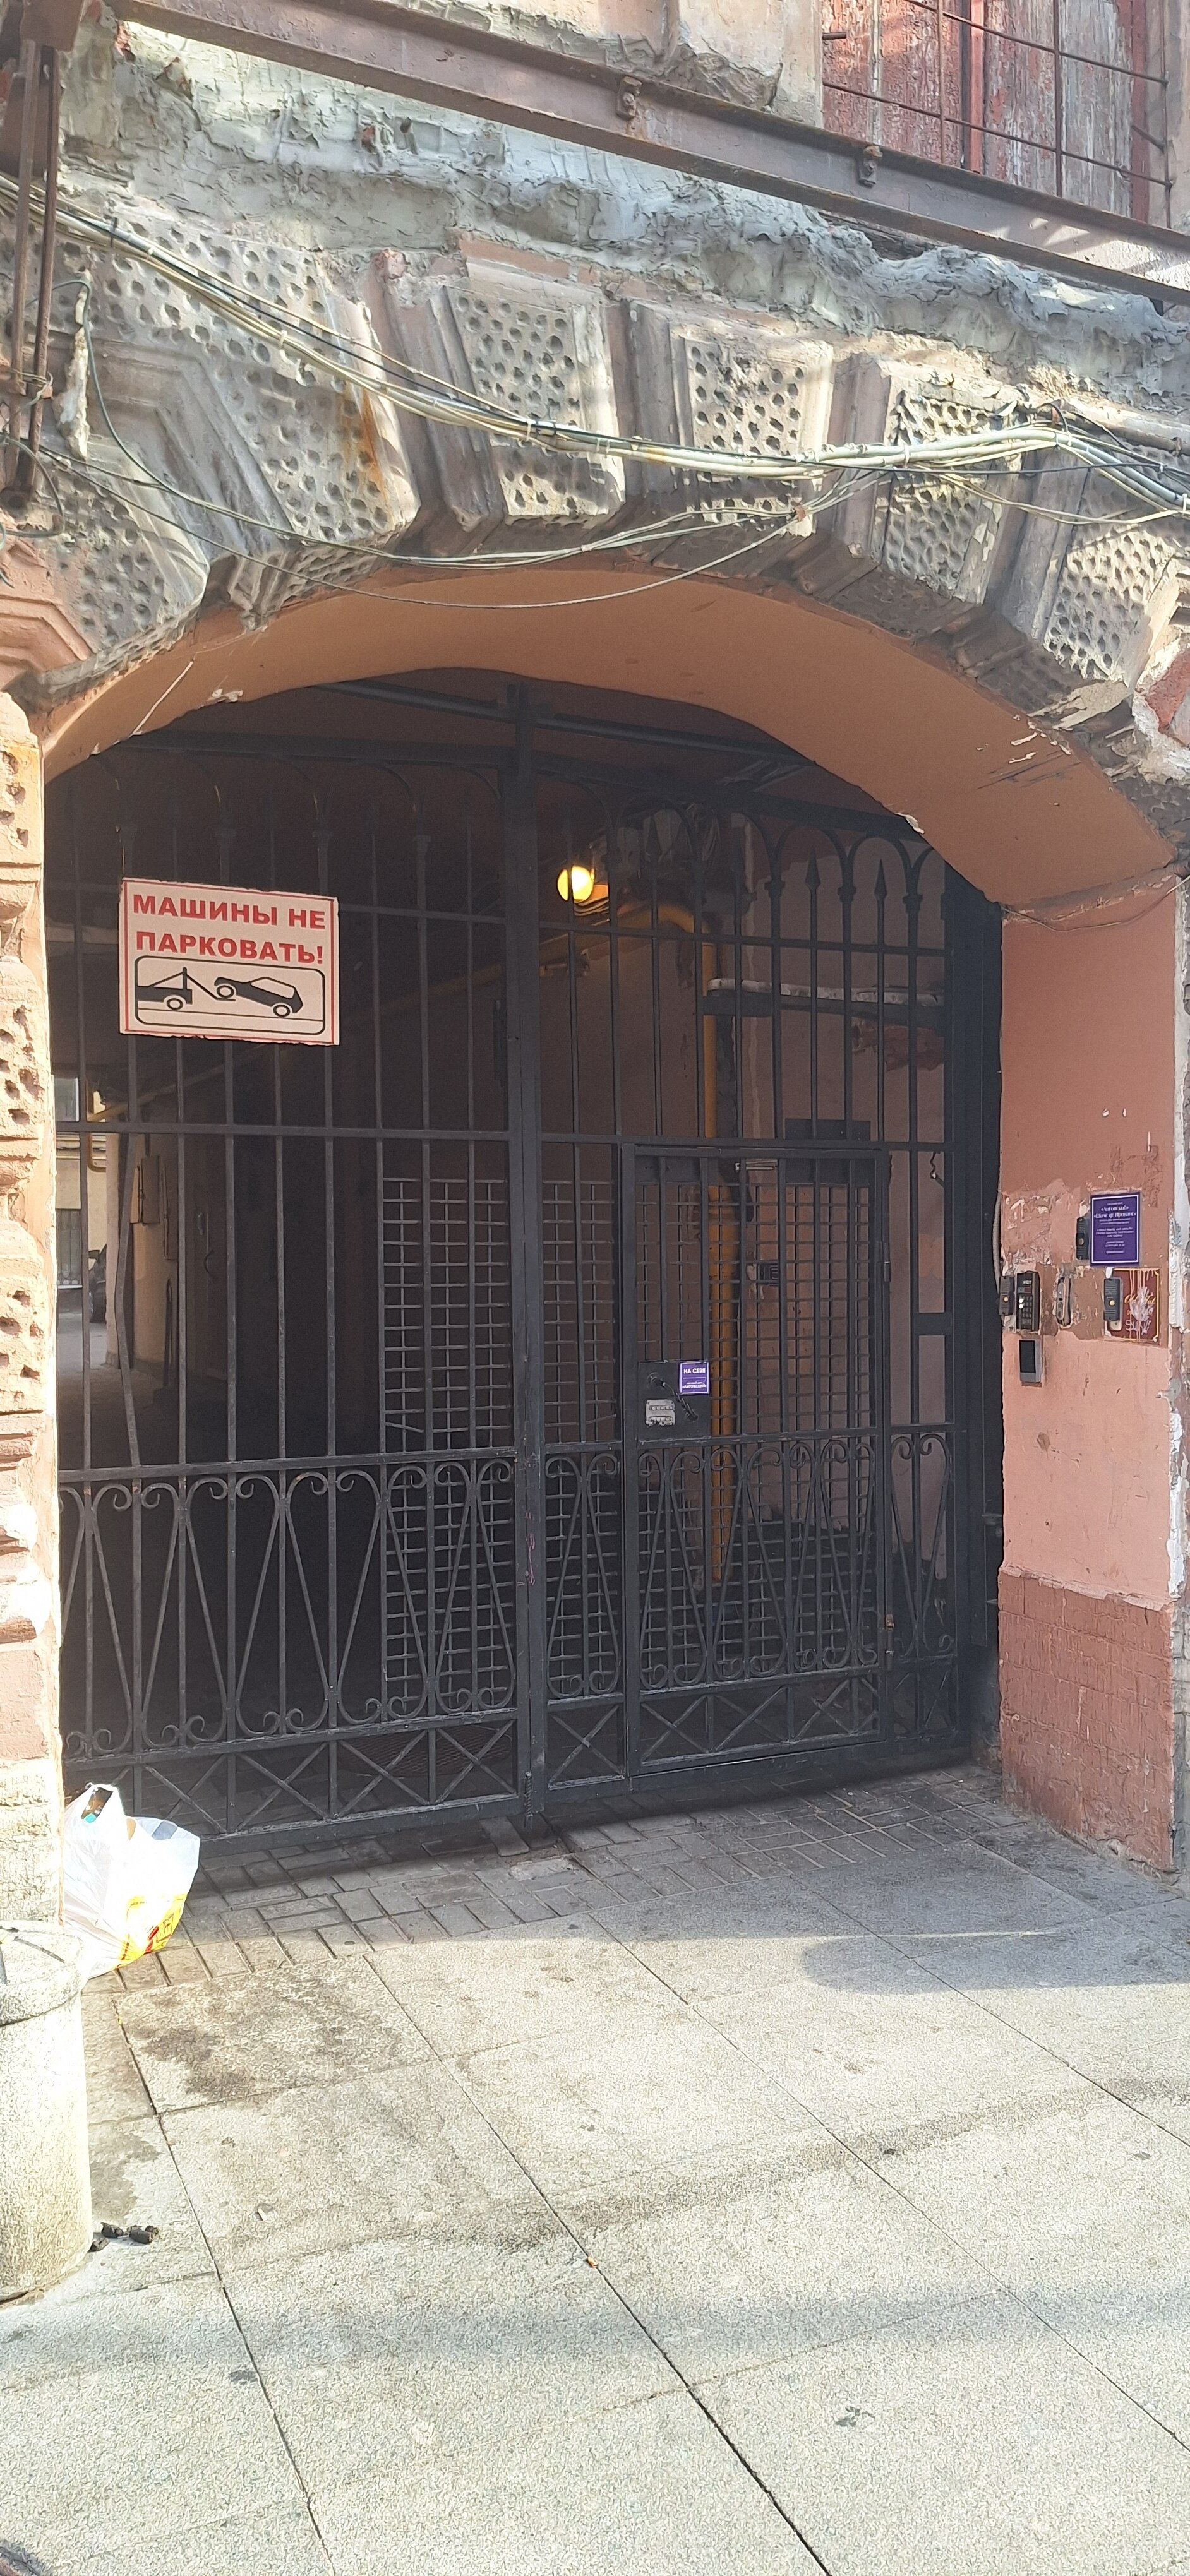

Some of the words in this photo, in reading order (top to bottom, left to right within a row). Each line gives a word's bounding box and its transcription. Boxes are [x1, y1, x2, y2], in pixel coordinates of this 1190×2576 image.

[133, 894, 277, 926] МАШИНЫ
[288, 908, 326, 930] НЕ
[136, 931, 323, 965] ПАРКОВАТЬ!
